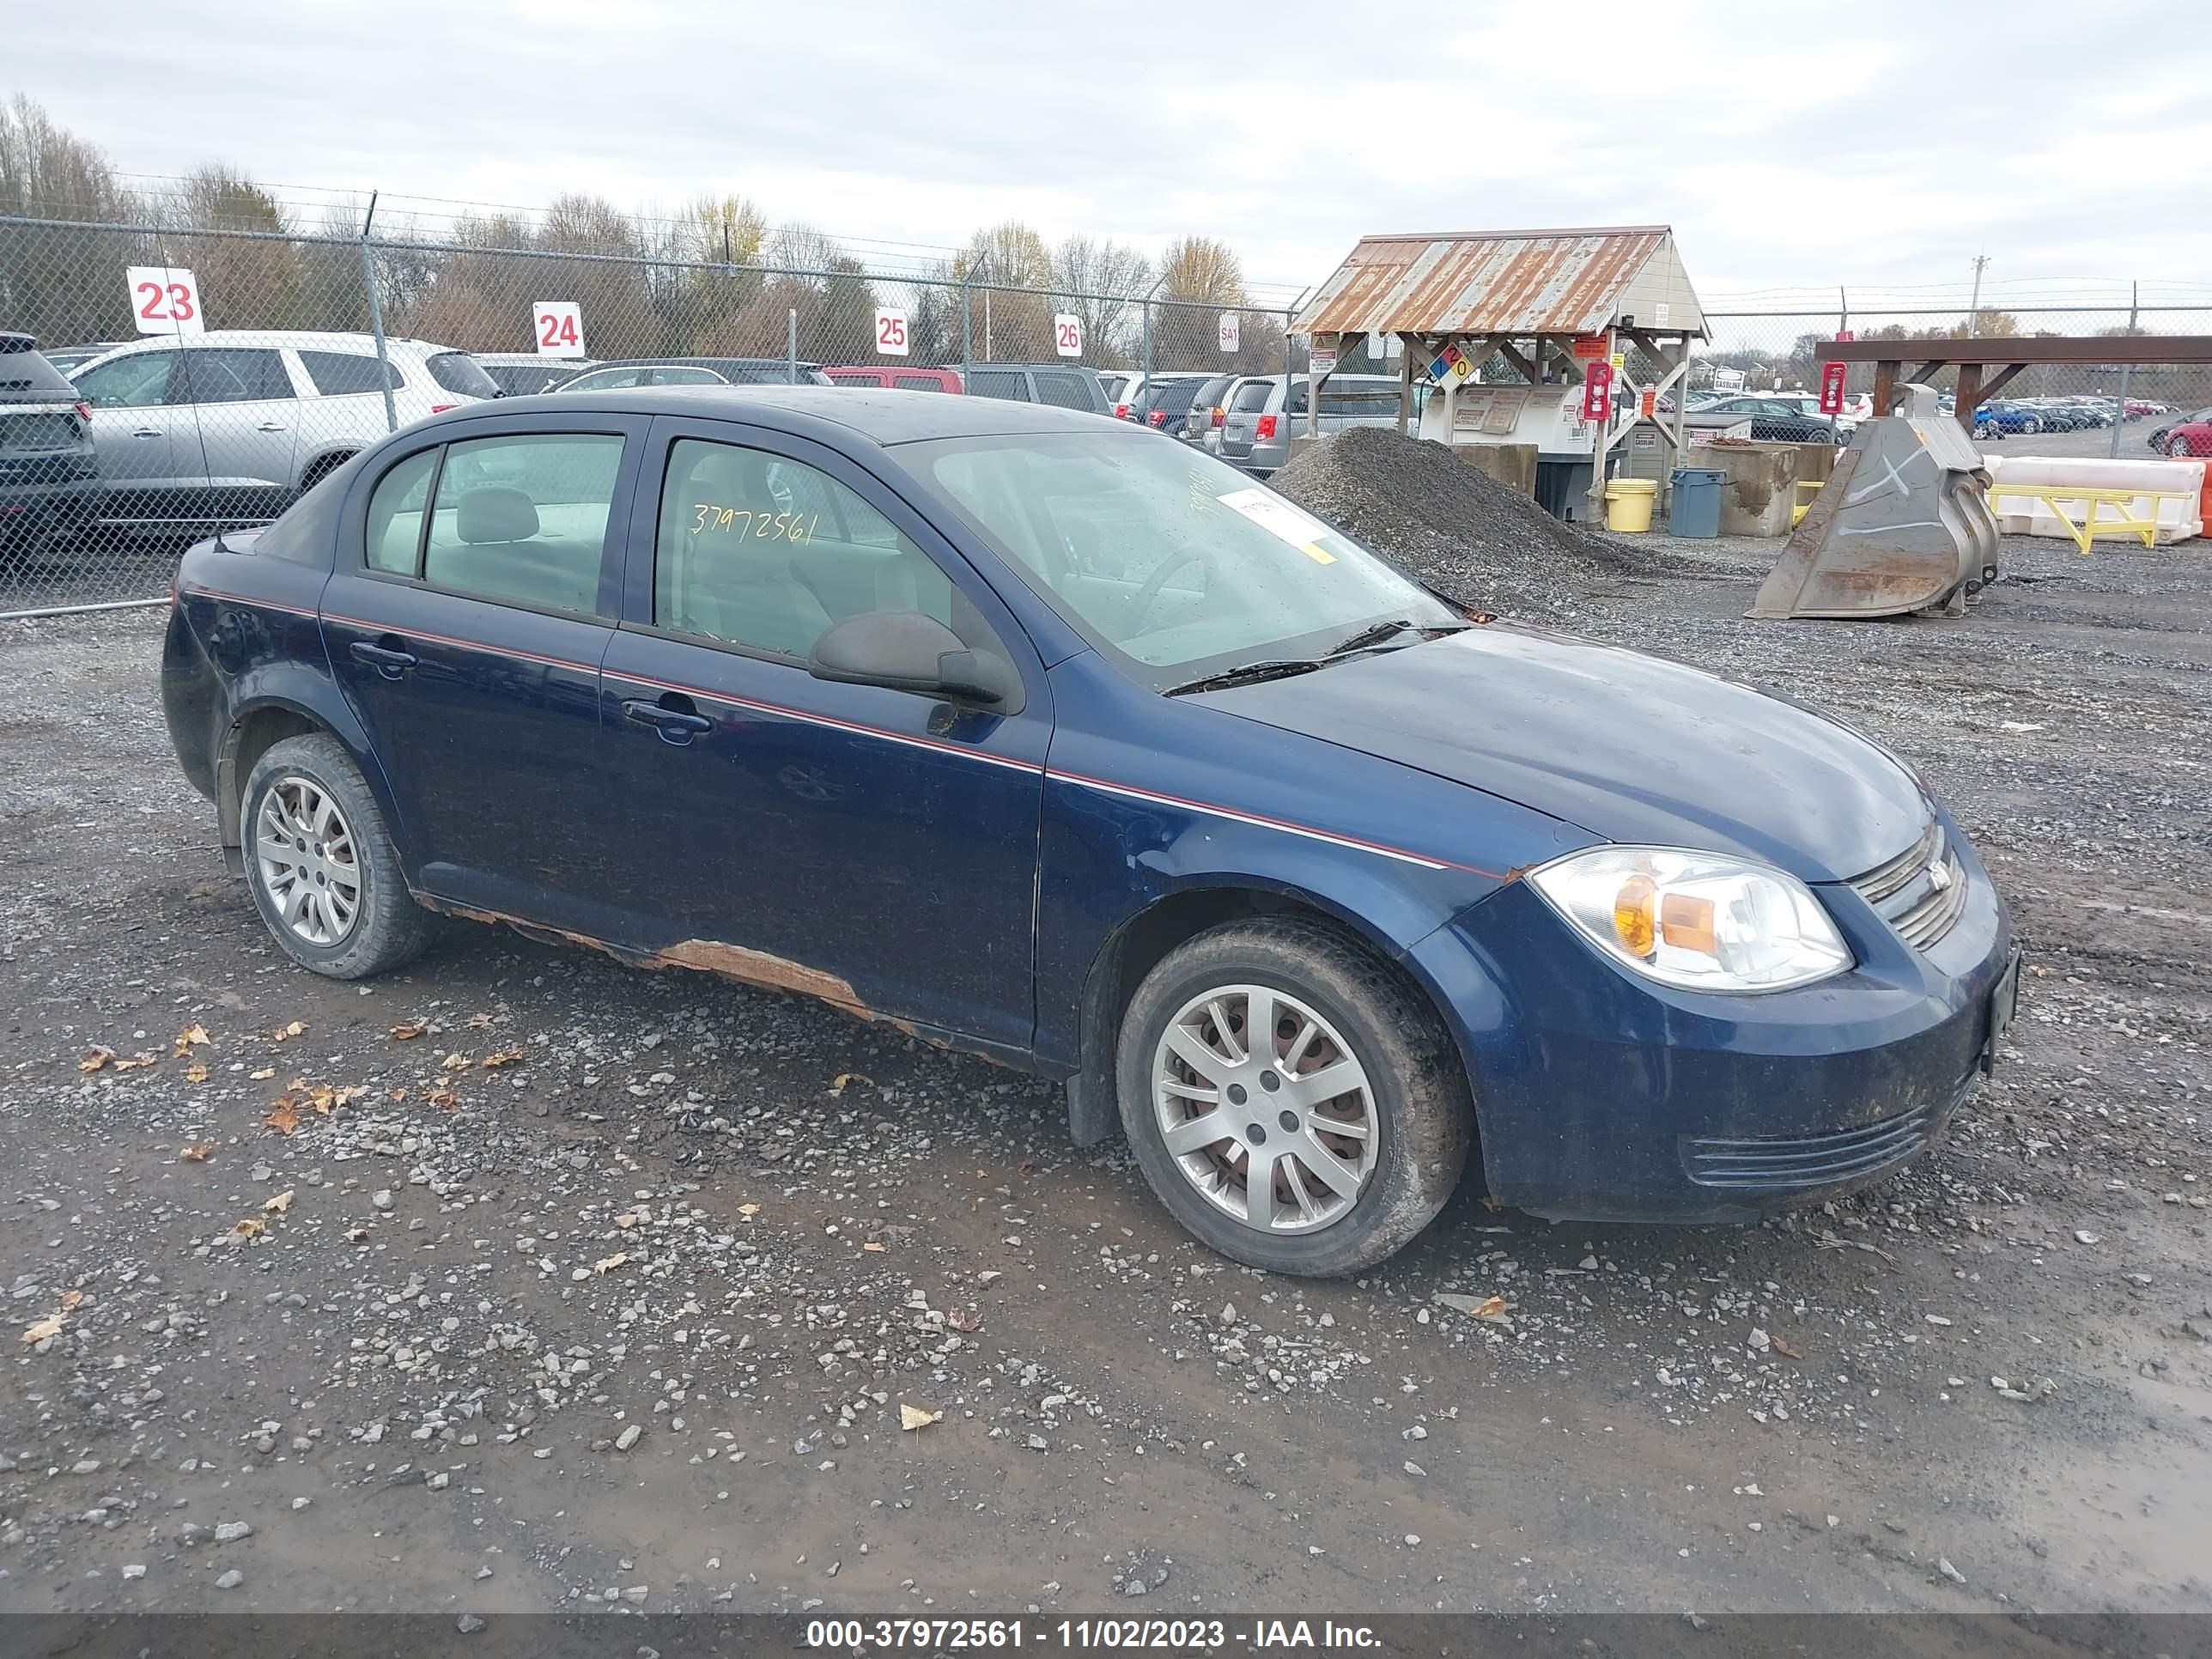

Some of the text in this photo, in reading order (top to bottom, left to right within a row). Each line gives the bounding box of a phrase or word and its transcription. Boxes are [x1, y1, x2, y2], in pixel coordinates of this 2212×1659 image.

[137, 282, 193, 320] 23
[540, 314, 578, 346] 24
[879, 317, 905, 345] 25
[1059, 324, 1079, 348] 26
[1448, 348, 1459, 362] 2
[1437, 360, 1443, 375] 1
[1457, 361, 1467, 376] 0
[1715, 380, 1741, 390] GASOLINE
[690, 504, 818, 547] 37972561
